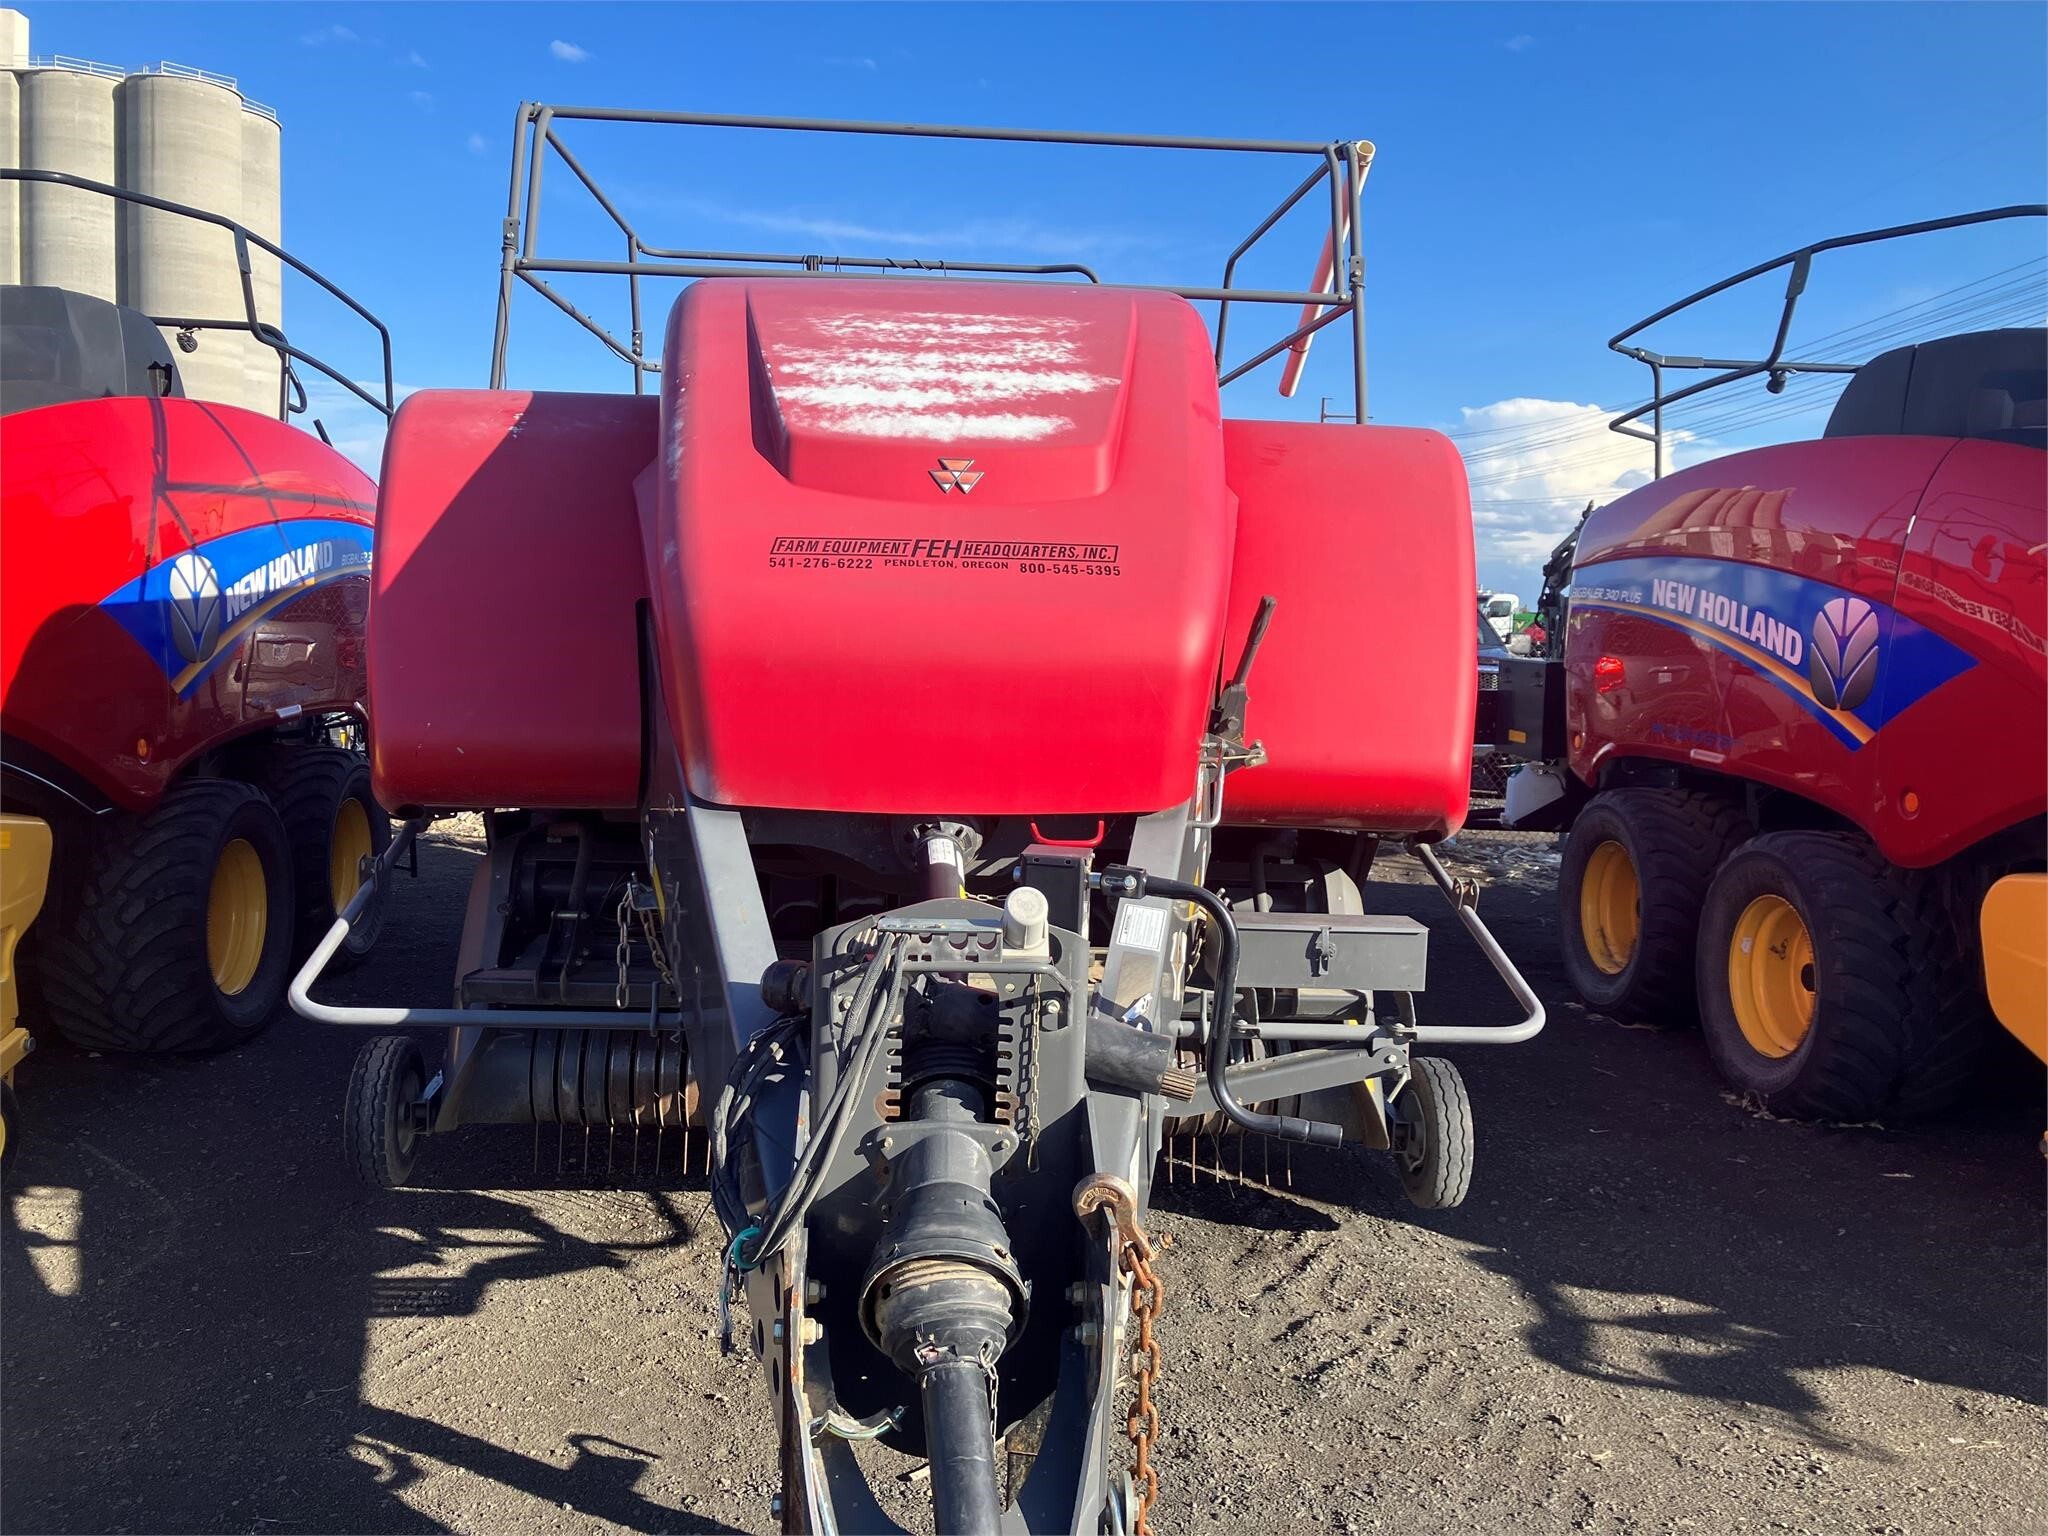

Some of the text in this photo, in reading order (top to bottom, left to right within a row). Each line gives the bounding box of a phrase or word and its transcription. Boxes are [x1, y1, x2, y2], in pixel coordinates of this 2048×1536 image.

[776, 539, 1112, 560] FARM EQUIPMENT FEH HEADQUARTERS, INC.
[769, 557, 1121, 576] 541-276-6222 PENDLETON, OREGON 800-545-5395
[226, 541, 333, 623] NEW HOLLAND
[1572, 587, 1642, 604] BIGBALER 340 PLUS
[1652, 578, 1803, 666] NEW HOLLAND
